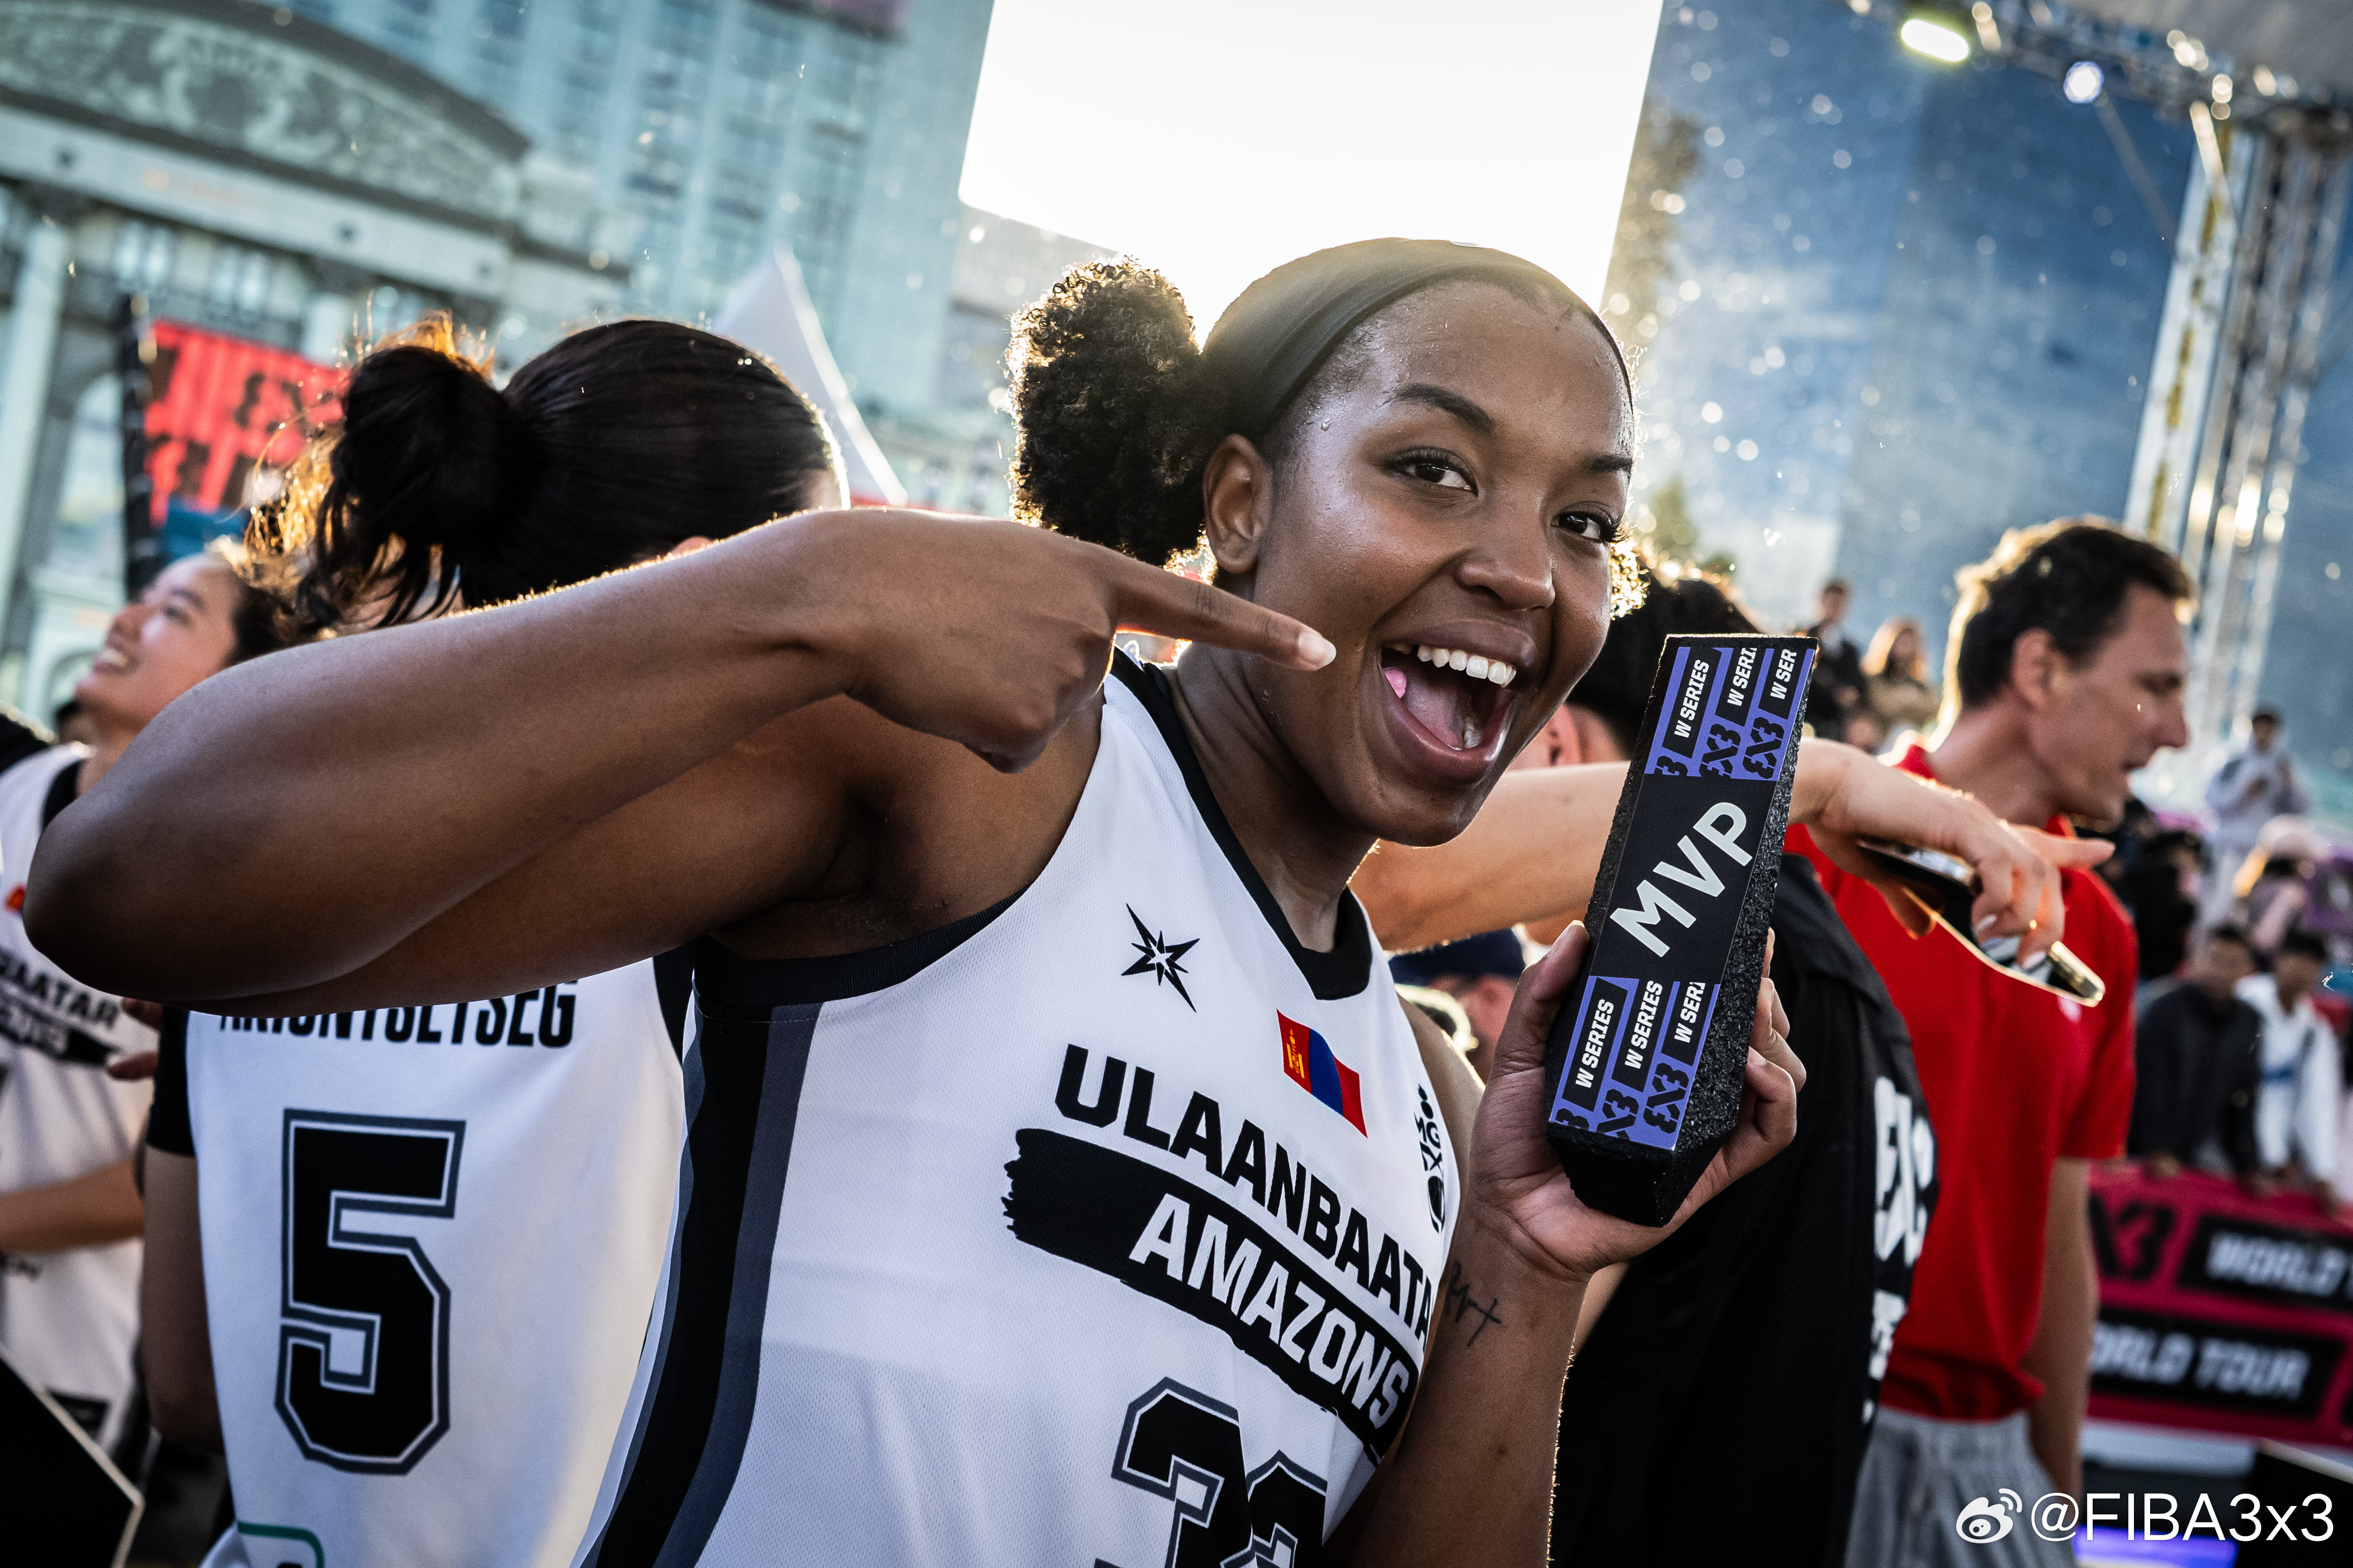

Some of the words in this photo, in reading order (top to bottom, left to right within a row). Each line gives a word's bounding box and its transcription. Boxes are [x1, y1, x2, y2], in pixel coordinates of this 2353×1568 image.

[1732, 647, 1757, 689] SERI
[1775, 649, 1797, 683] SER
[1680, 659, 1709, 721] SERIES
[1727, 688, 1744, 707] W
[1770, 682, 1788, 700] W
[1674, 720, 1692, 738] W
[1610, 801, 1753, 957] MVP
[1582, 999, 1614, 1068] SERIES
[1631, 980, 1663, 1049] SERIES
[1674, 1023, 1693, 1043] W
[1575, 1067, 1594, 1088] W
[1624, 1049, 1644, 1069] W
[275, 1107, 466, 1477] 5
[1129, 1193, 1409, 1429] AMAZONS
